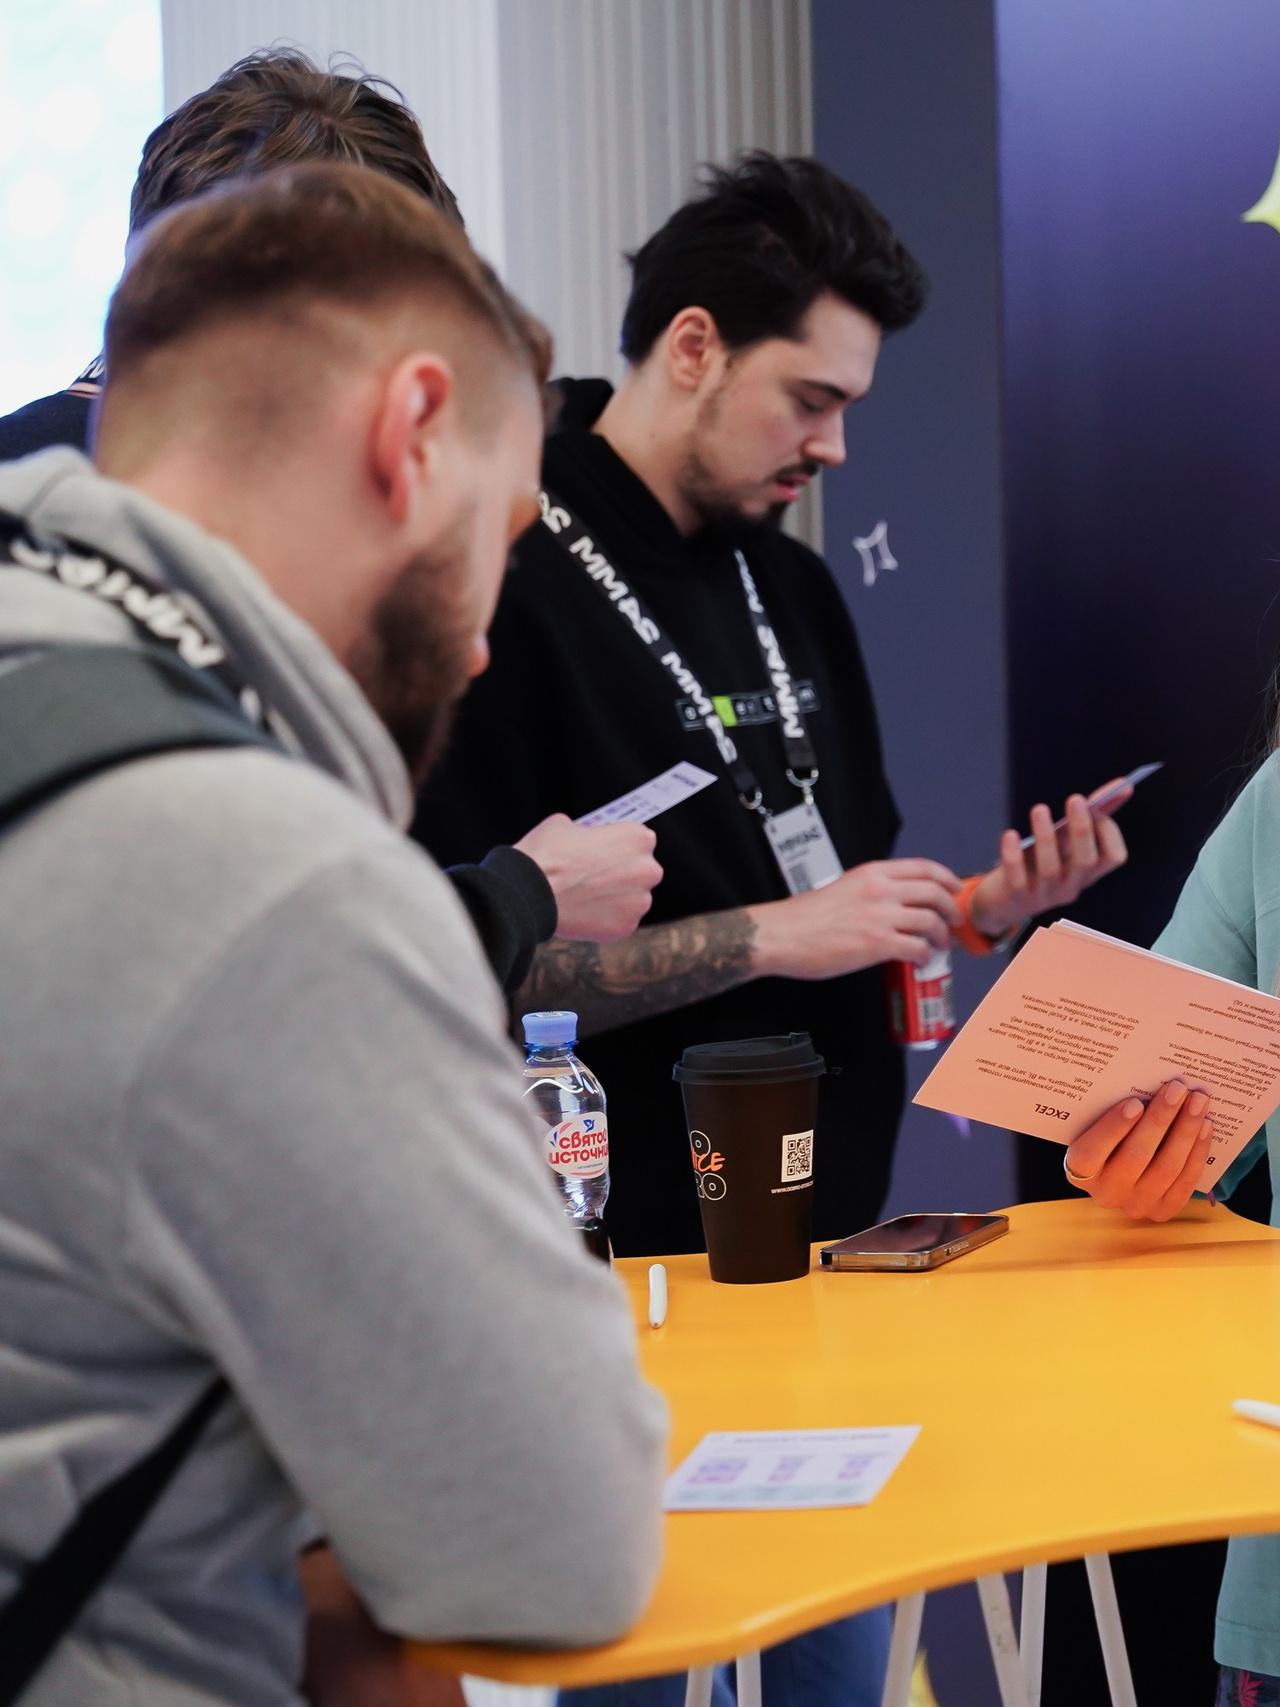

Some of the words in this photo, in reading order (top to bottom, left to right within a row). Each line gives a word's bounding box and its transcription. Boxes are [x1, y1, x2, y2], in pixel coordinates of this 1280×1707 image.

[1021, 994, 1057, 1008] посчитать
[1059, 997, 1118, 1017] дополнительное.
[1188, 1002, 1214, 1012] данные
[1023, 1003, 1048, 1014] можно
[1213, 1009, 1238, 1020] разные
[1226, 1006, 1256, 1018] варианте
[1249, 1005, 1276, 1016] графики
[1047, 1011, 1068, 1021] Excel
[1117, 1014, 1139, 1024] что-то
[1023, 1020, 1045, 1030] ждать
[1107, 1019, 1134, 1031] сделать
[1175, 1021, 1204, 1034] большие
[1237, 1016, 1276, 1032] представить
[999, 1022, 1053, 1040] разработчиков
[1054, 1028, 1092, 1043] доработку
[1053, 1037, 1082, 1049] просить
[1213, 1033, 1235, 1043] отклик
[1016, 1043, 1037, 1053] легко
[1091, 1040, 1119, 1051] сделать
[1235, 1040, 1264, 1052] быстрый
[1043, 1051, 1070, 1063] быстро
[1068, 1050, 1108, 1065] подправить
[1168, 1042, 1222, 1062] воспринимаются,
[975, 1057, 997, 1067] знают
[1070, 1059, 1096, 1071] Можно
[1158, 1056, 1200, 1071] информации
[1199, 1059, 1235, 1074] аудиторию,
[1222, 1059, 1250, 1072] быстрее
[1241, 1057, 1268, 1069] таблицы.
[977, 1066, 1003, 1077] готовы
[1234, 1071, 1263, 1084] большую
[1250, 1068, 1277, 1079] графики
[1003, 1074, 1053, 1091] руководители
[1182, 1071, 1220, 1085] инструмент
[1199, 1068, 1256, 1088] распространения
[1047, 1078, 1088, 1093] переходить
[1219, 1082, 1256, 1097] Идеальный
[1221, 1099, 1246, 1110] Единый
[1035, 1103, 1070, 1120] EXCEL
[1217, 1113, 1238, 1122] завтра
